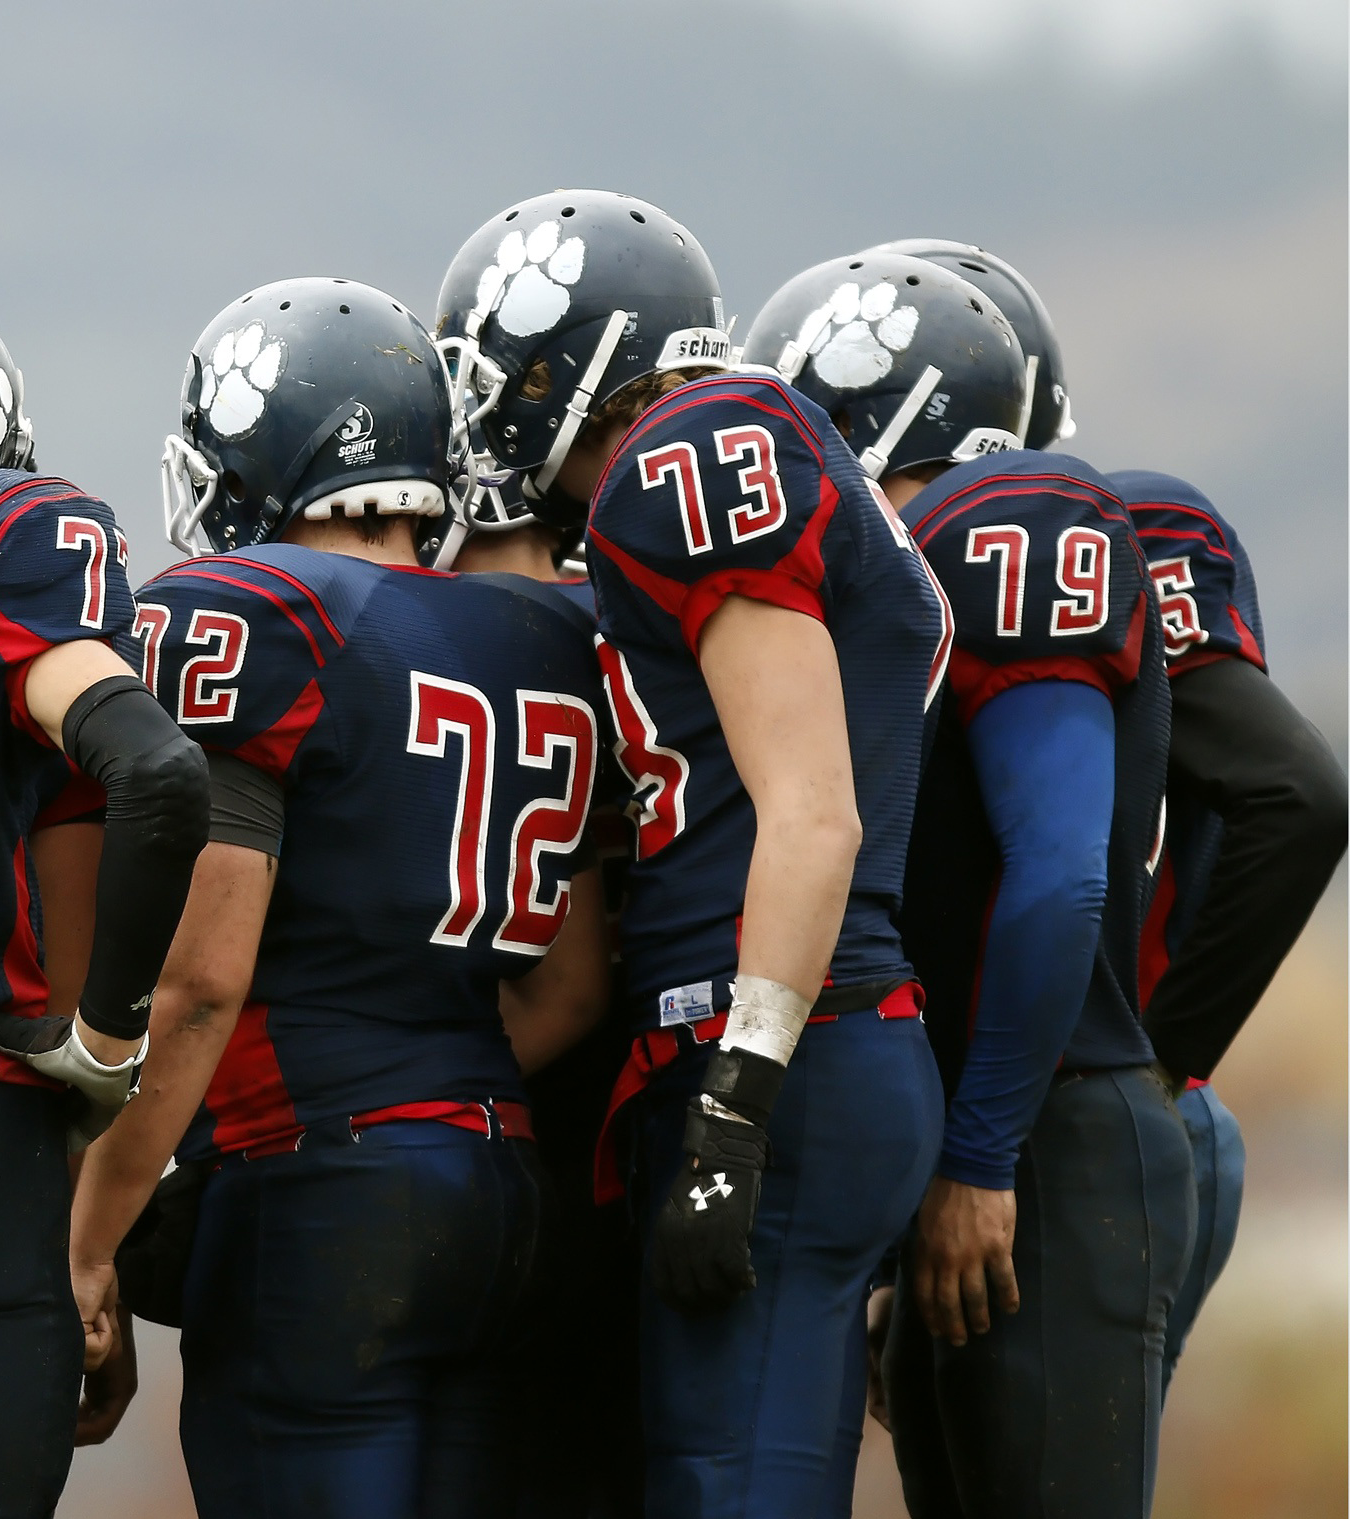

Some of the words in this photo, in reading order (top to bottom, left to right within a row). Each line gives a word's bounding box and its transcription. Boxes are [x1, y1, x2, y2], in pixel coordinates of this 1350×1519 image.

[338, 439, 377, 457] SCHUTT
[638, 424, 787, 557] 73
[965, 524, 1111, 637] 79
[131, 602, 250, 724] 72
[406, 670, 598, 956] 72
